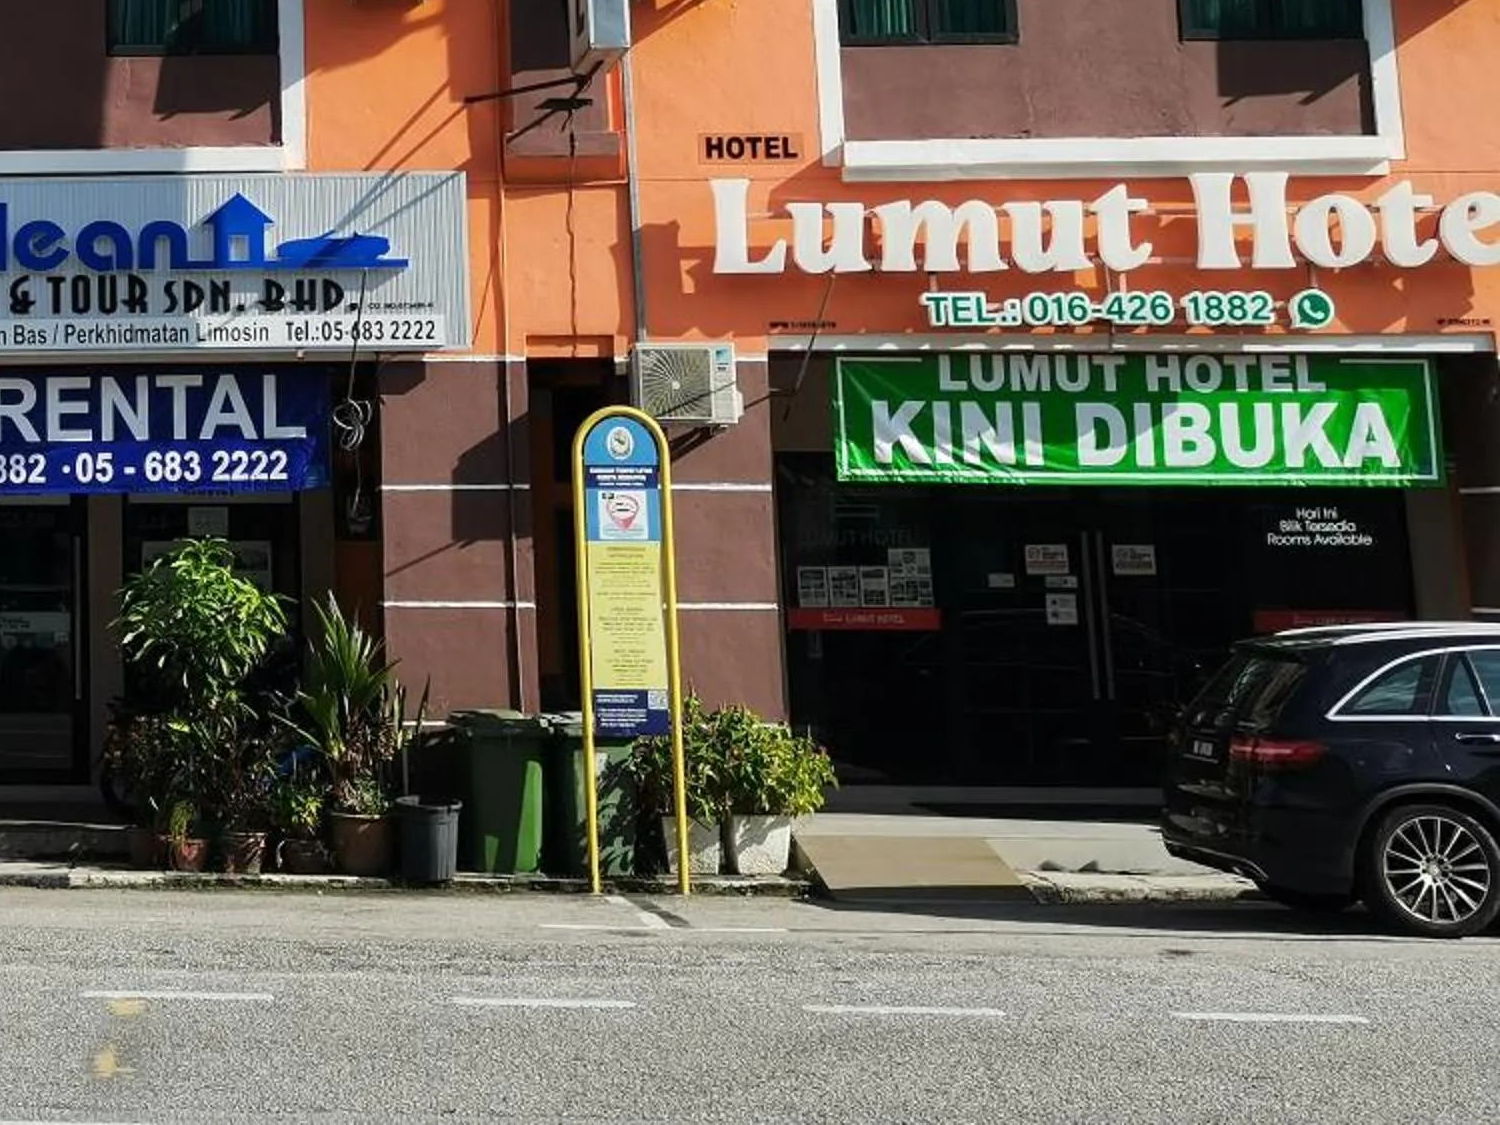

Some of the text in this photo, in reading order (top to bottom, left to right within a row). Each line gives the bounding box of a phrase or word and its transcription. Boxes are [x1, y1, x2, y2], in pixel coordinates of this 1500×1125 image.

[704, 136, 799, 160] HOTEL
[710, 177, 1154, 275] Lumut
[8, 276, 37, 314] &
[47, 275, 149, 314] TOUR
[163, 279, 246, 314] SDN.
[259, 278, 360, 313] BHD.
[1186, 291, 1273, 324] 1882
[13, 323, 48, 346] Bas
[64, 322, 189, 344] Perkhidmatan
[196, 322, 270, 343] Limosin
[390, 320, 436, 341] 2222
[938, 354, 1326, 393] LUMUT HOTEL
[871, 400, 1402, 469] KINI DIBUKA
[144, 450, 202, 482] 683
[211, 449, 288, 482] 2222
[1279, 520, 1357, 532] Bilik Tersedia
[1296, 507, 1339, 520] Hari Ini
[1267, 533, 1373, 545] Rooms Available
